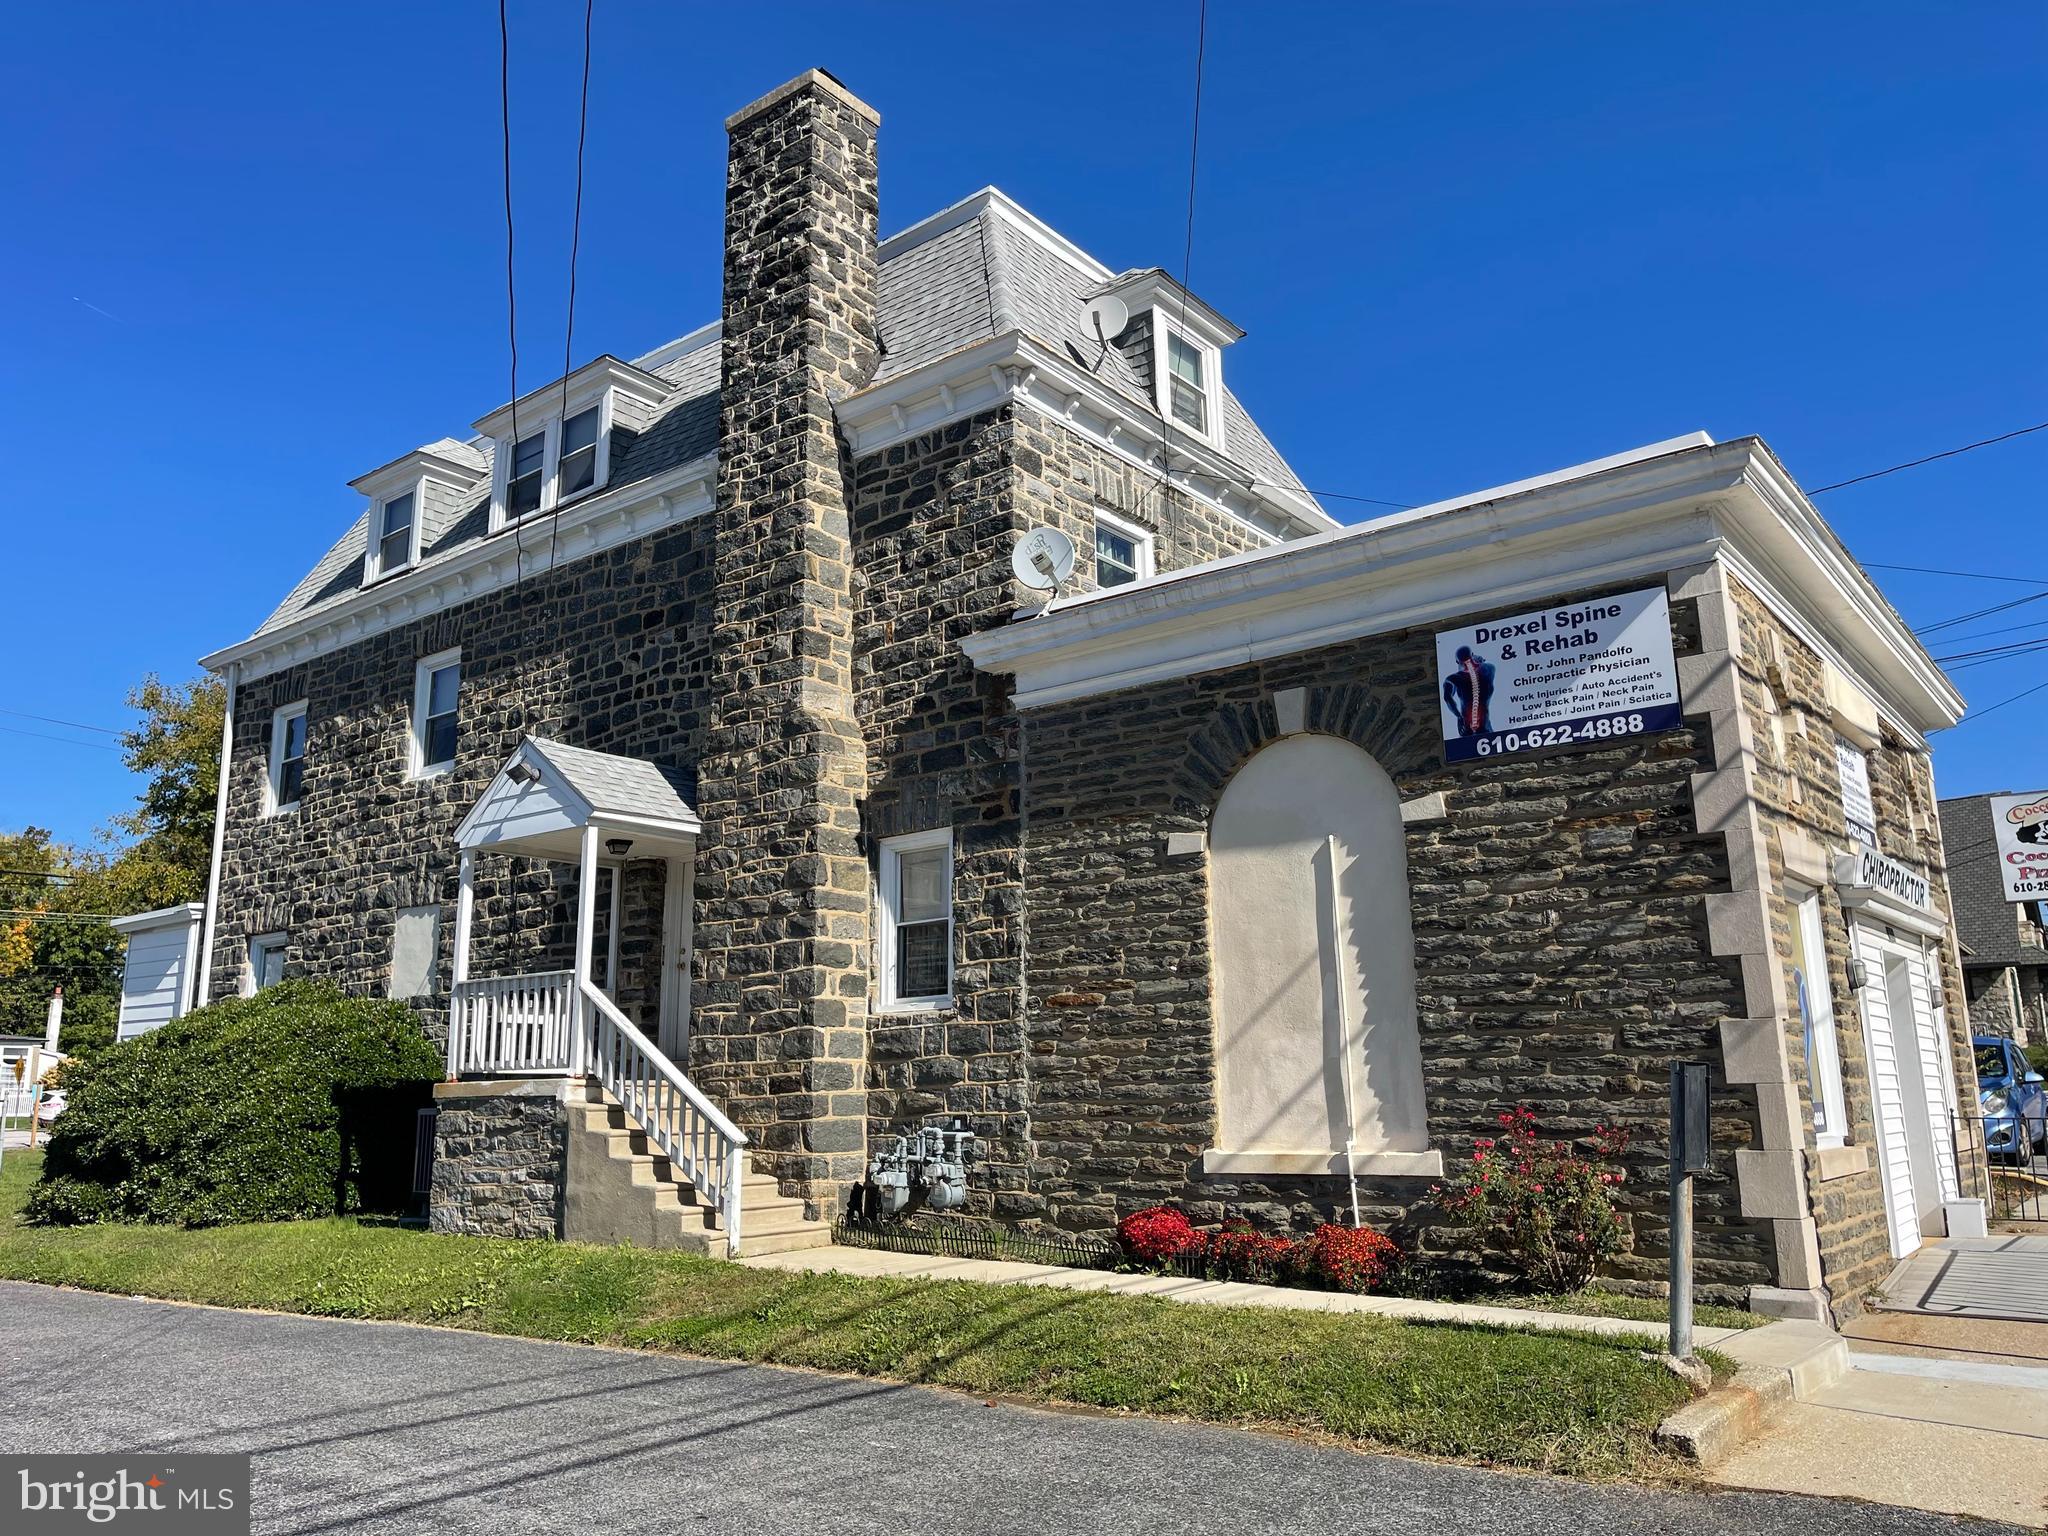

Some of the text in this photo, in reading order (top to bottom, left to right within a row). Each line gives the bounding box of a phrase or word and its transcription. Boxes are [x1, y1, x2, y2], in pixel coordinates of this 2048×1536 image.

[1476, 605, 1621, 644] Drexel Spine
[1501, 629, 1598, 660] & Rehab
[1527, 645, 1633, 672] Dr. John Pandolfo
[1510, 694, 1534, 703] Work
[1537, 686, 1573, 700] Injuries
[1582, 680, 1605, 690] Auto
[1608, 671, 1662, 686] Accident's
[1514, 656, 1650, 687] Chiropractic Physician
[1509, 709, 1562, 723] Headaches
[1571, 703, 1595, 713] Joint
[1599, 698, 1620, 708] Pain
[1629, 691, 1672, 703] Sciatica
[1523, 702, 1542, 711] Low
[1545, 696, 1569, 707] Back
[1573, 693, 1593, 703] Pain
[1603, 688, 1628, 697] Neck
[1632, 683, 1654, 693] Pain
[1476, 714, 1644, 756] 610-622-4888
[1863, 852, 1925, 908] CHIROPRACTOR
